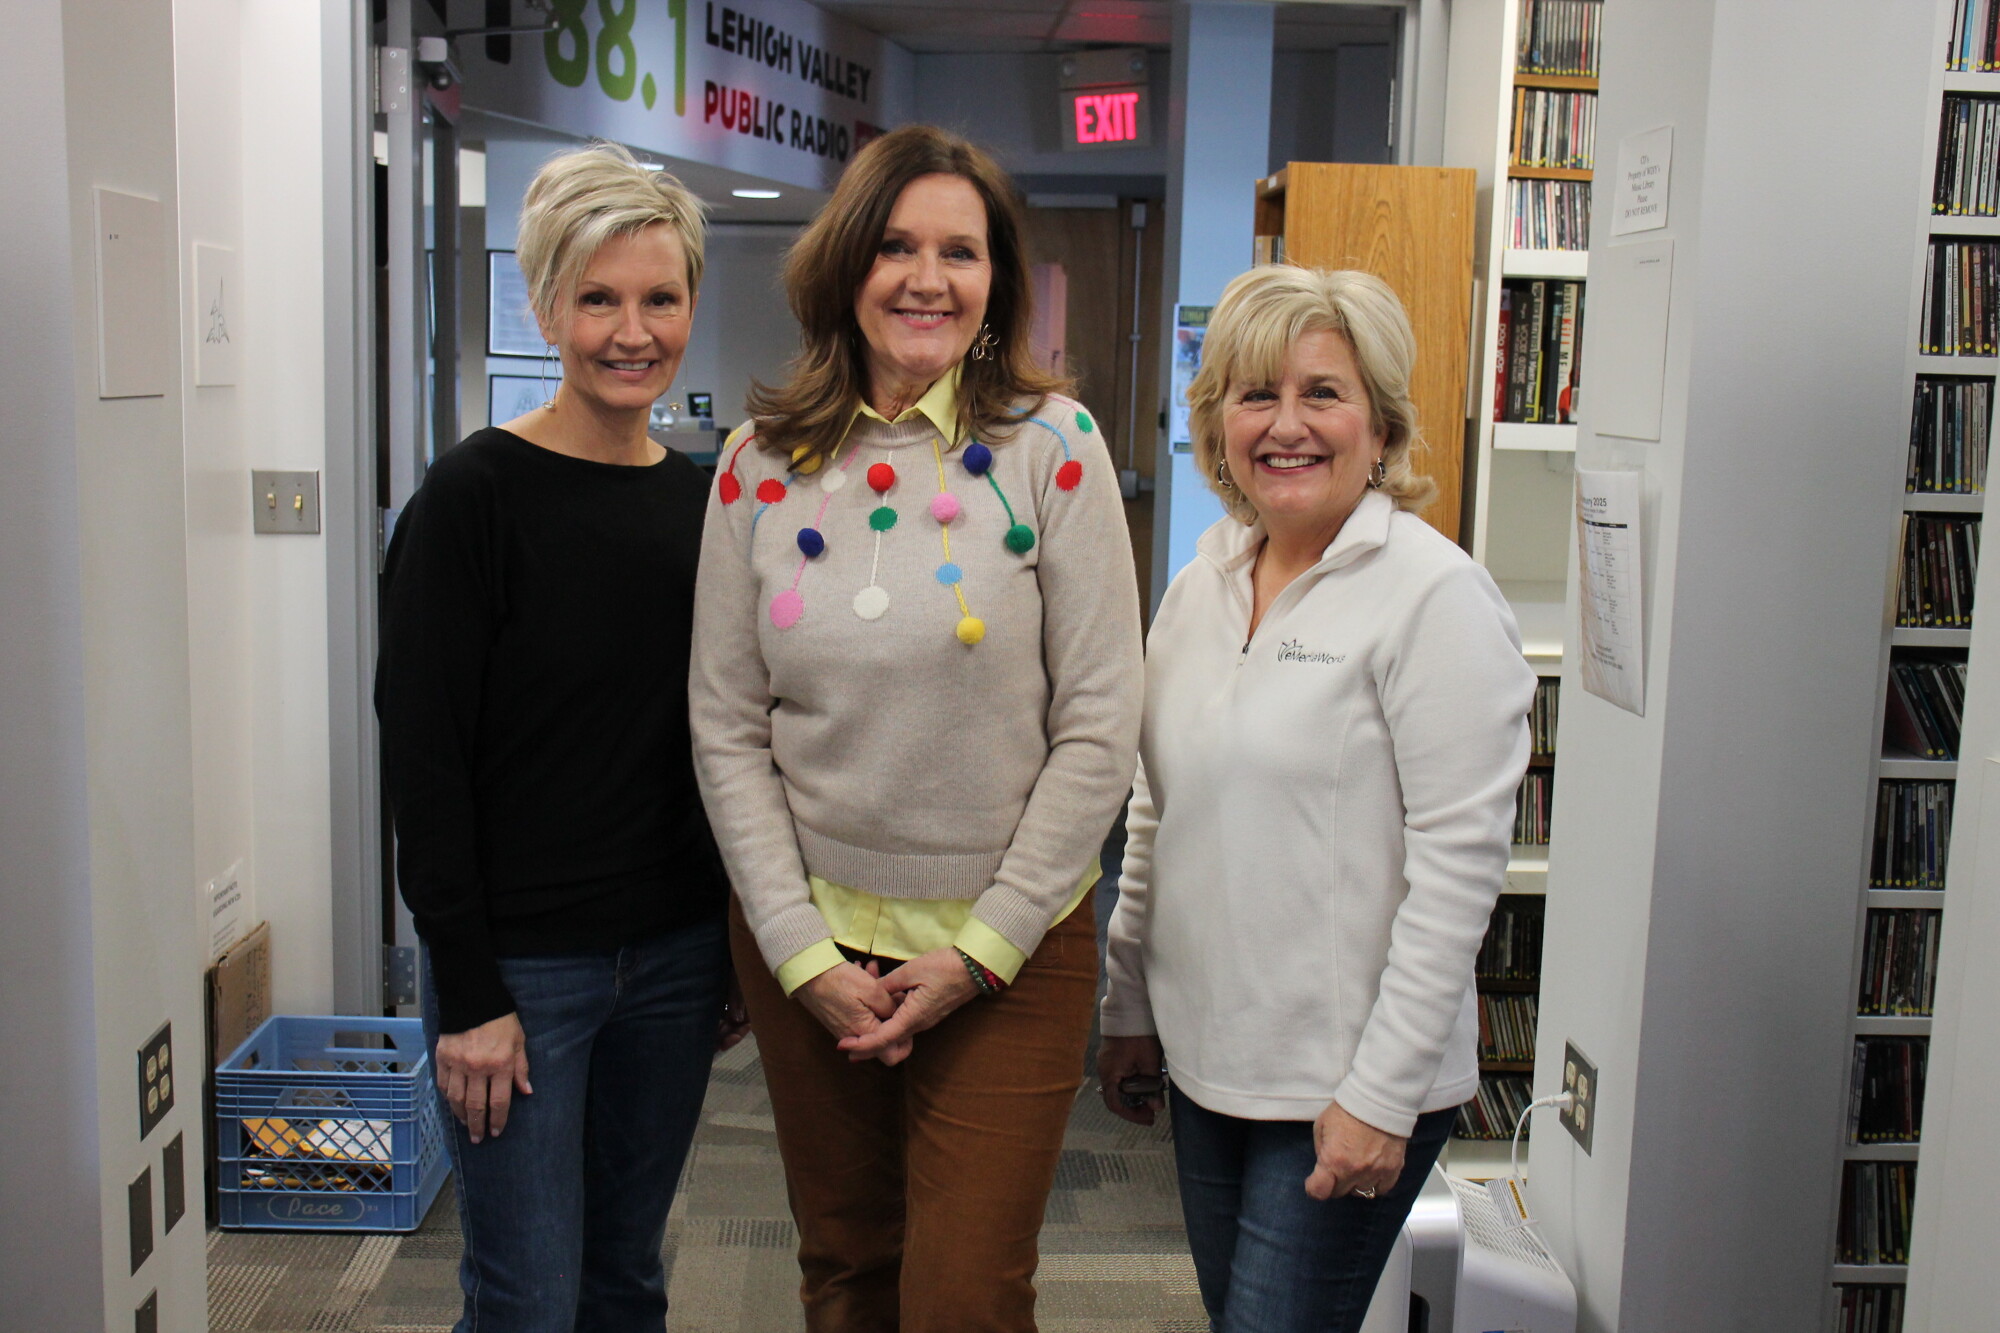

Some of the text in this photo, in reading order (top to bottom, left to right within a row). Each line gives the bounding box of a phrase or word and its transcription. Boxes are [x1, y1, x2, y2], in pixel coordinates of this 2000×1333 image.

[544, 0, 687, 117] 88.1
[706, 2, 871, 103] LEHIGH VALLEY
[705, 80, 849, 162] PUBLIC RADIO
[1074, 92, 1139, 144] EXIT
[1593, 497, 1607, 506] 2025
[288, 1197, 343, 1217] Pace
